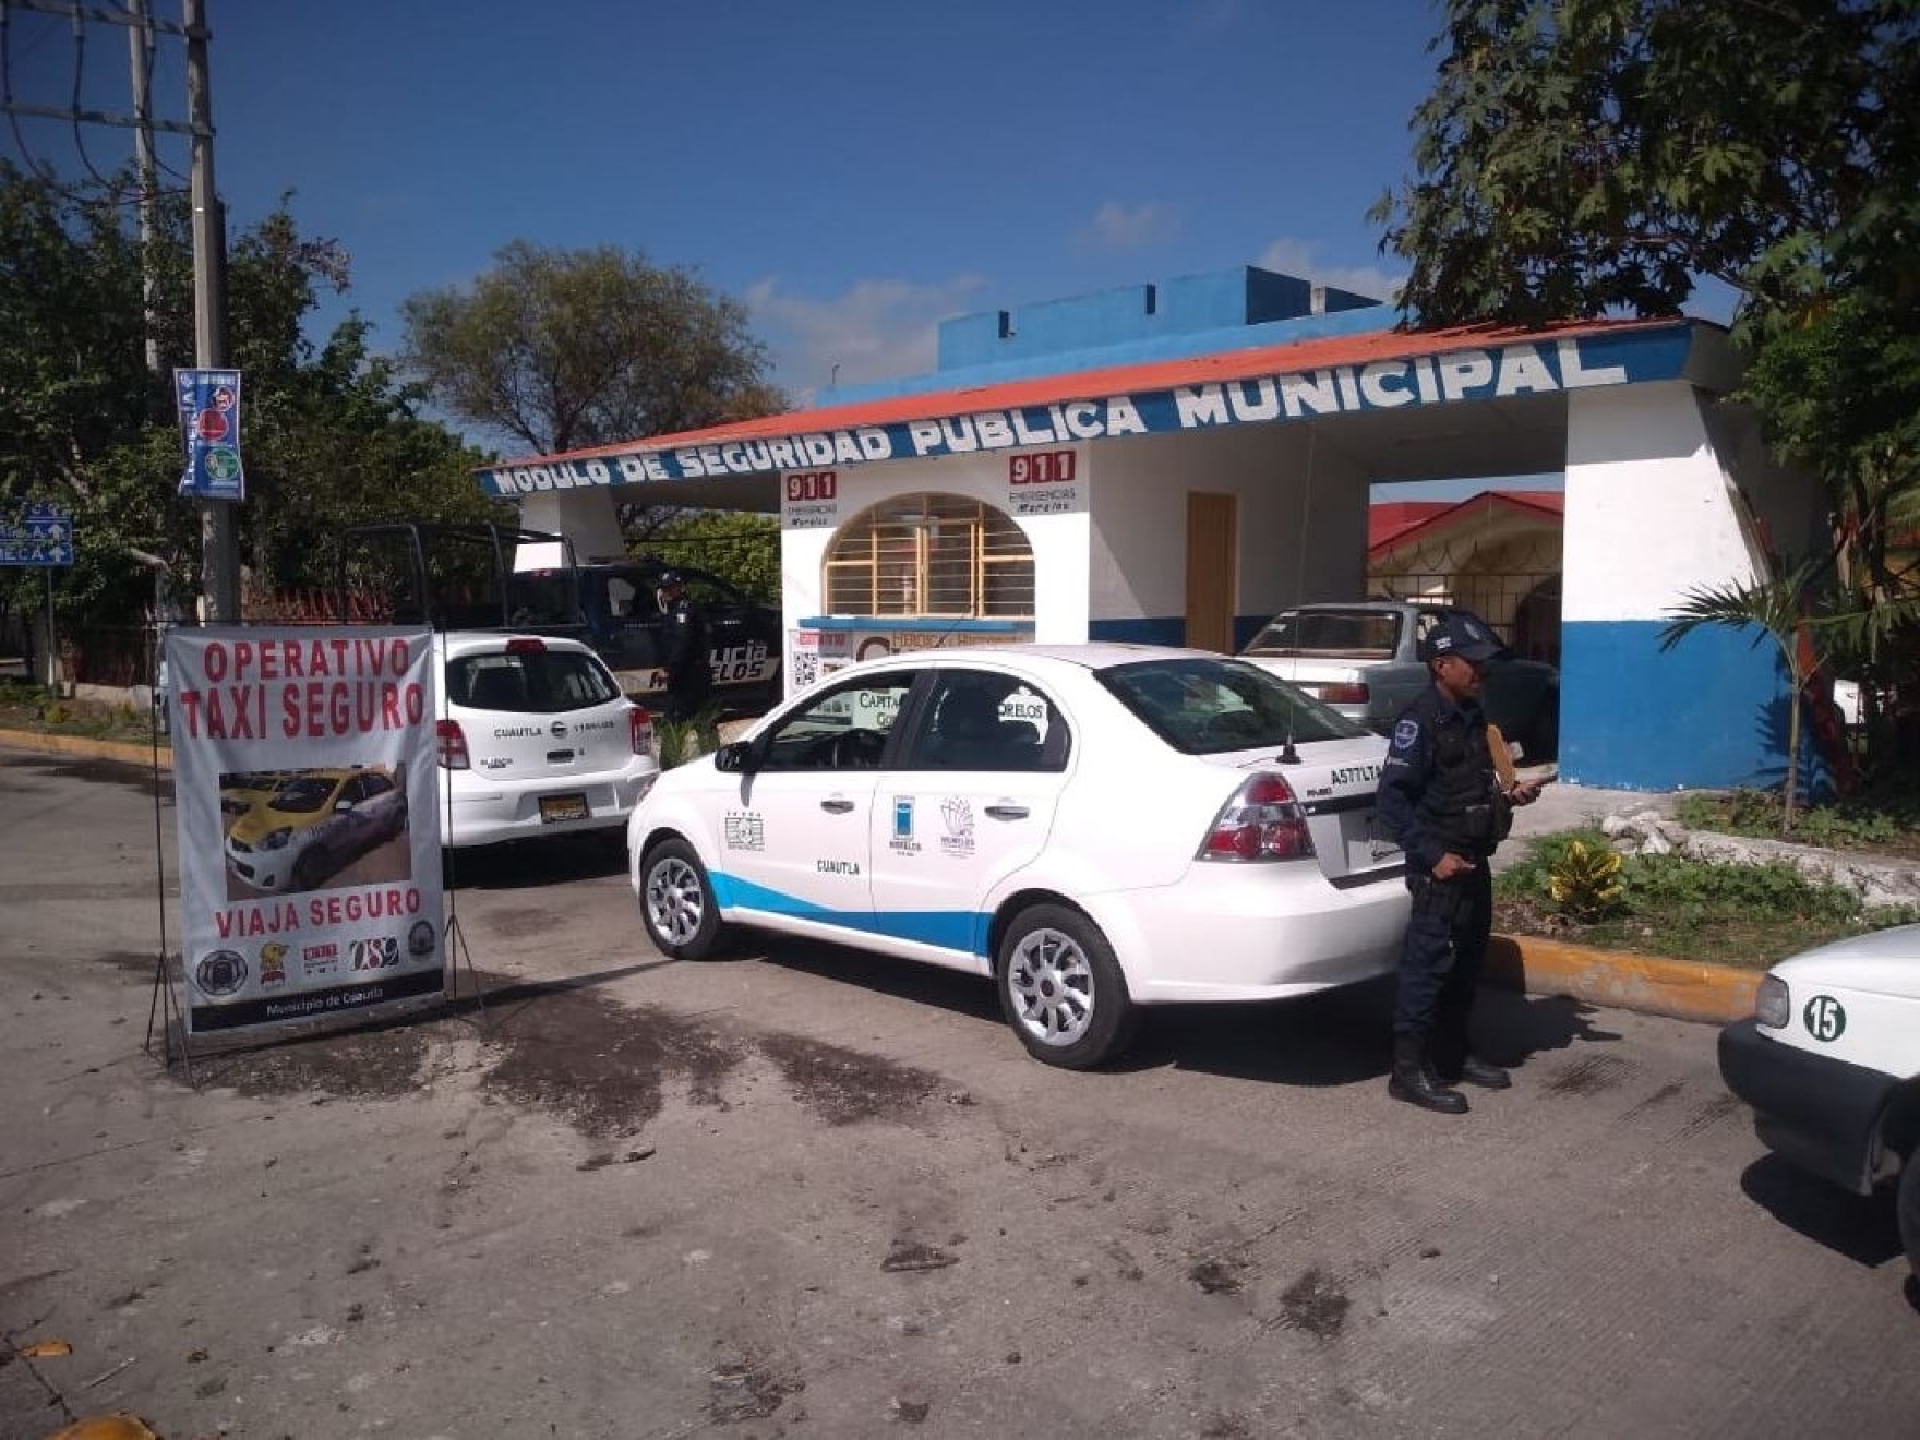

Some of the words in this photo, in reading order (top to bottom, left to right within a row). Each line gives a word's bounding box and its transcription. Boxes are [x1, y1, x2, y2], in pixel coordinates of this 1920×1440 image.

[493, 457, 613, 495] MODULO
[618, 450, 670, 483] DE
[674, 427, 893, 478] SEGURIDAD
[908, 398, 1150, 457] PUBLICA
[1174, 337, 1629, 430] MUNICIPAL
[789, 473, 833, 498] 911
[1011, 452, 1072, 482] 911
[204, 639, 410, 683] OPERATIVO
[180, 685, 267, 740] TAXI
[282, 681, 424, 739] SEGURO
[493, 726, 543, 738] CUAUTLA
[816, 859, 861, 876] CUAUTLA
[215, 903, 300, 938] VIAJA
[310, 888, 421, 926] SEGURO
[1810, 998, 1839, 1038] 15
